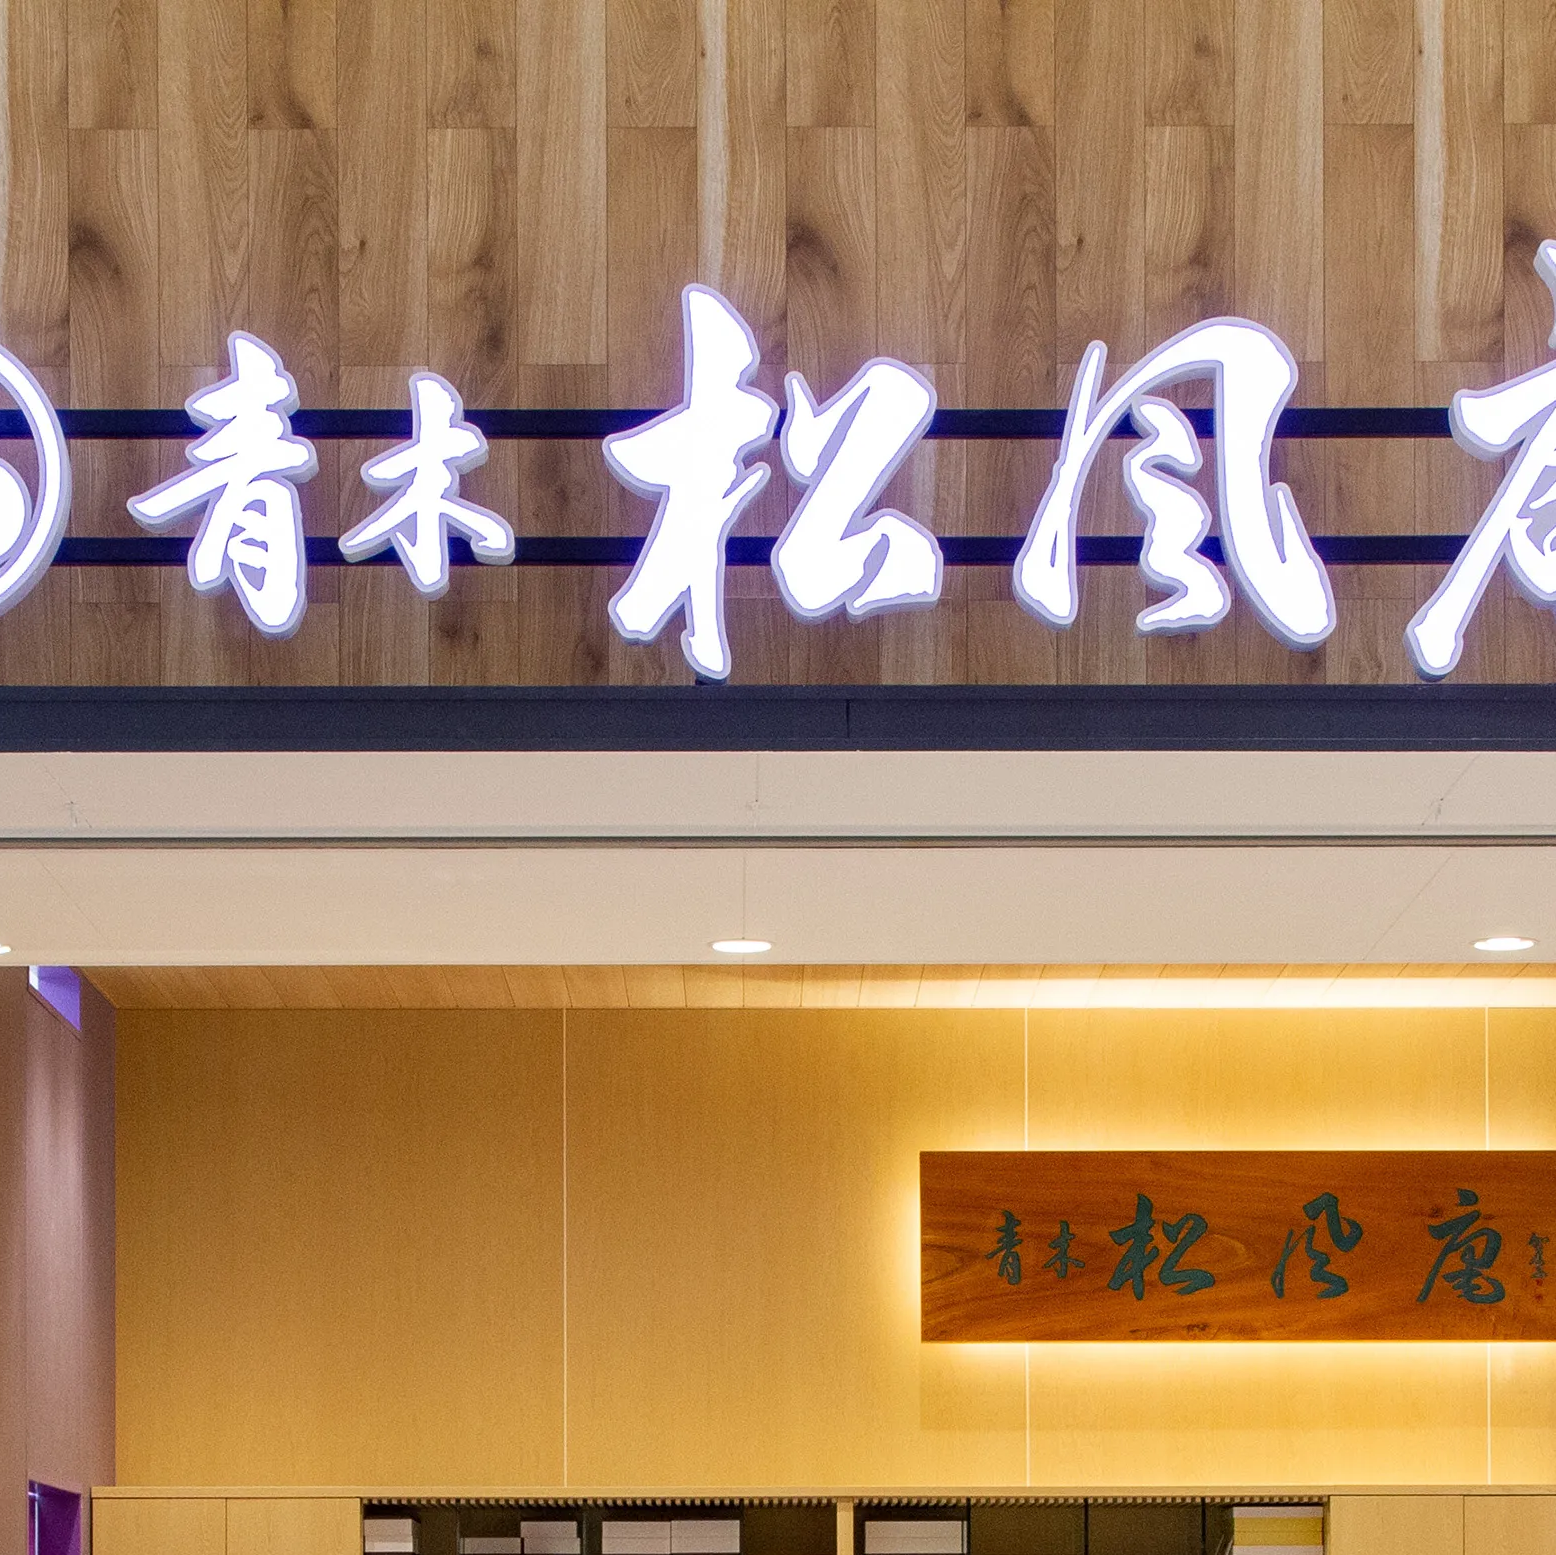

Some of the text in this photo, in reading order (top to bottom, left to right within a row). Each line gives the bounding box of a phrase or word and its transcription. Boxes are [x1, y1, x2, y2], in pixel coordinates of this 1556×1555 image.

[985, 1188, 1506, 1305] 青木松風庵
